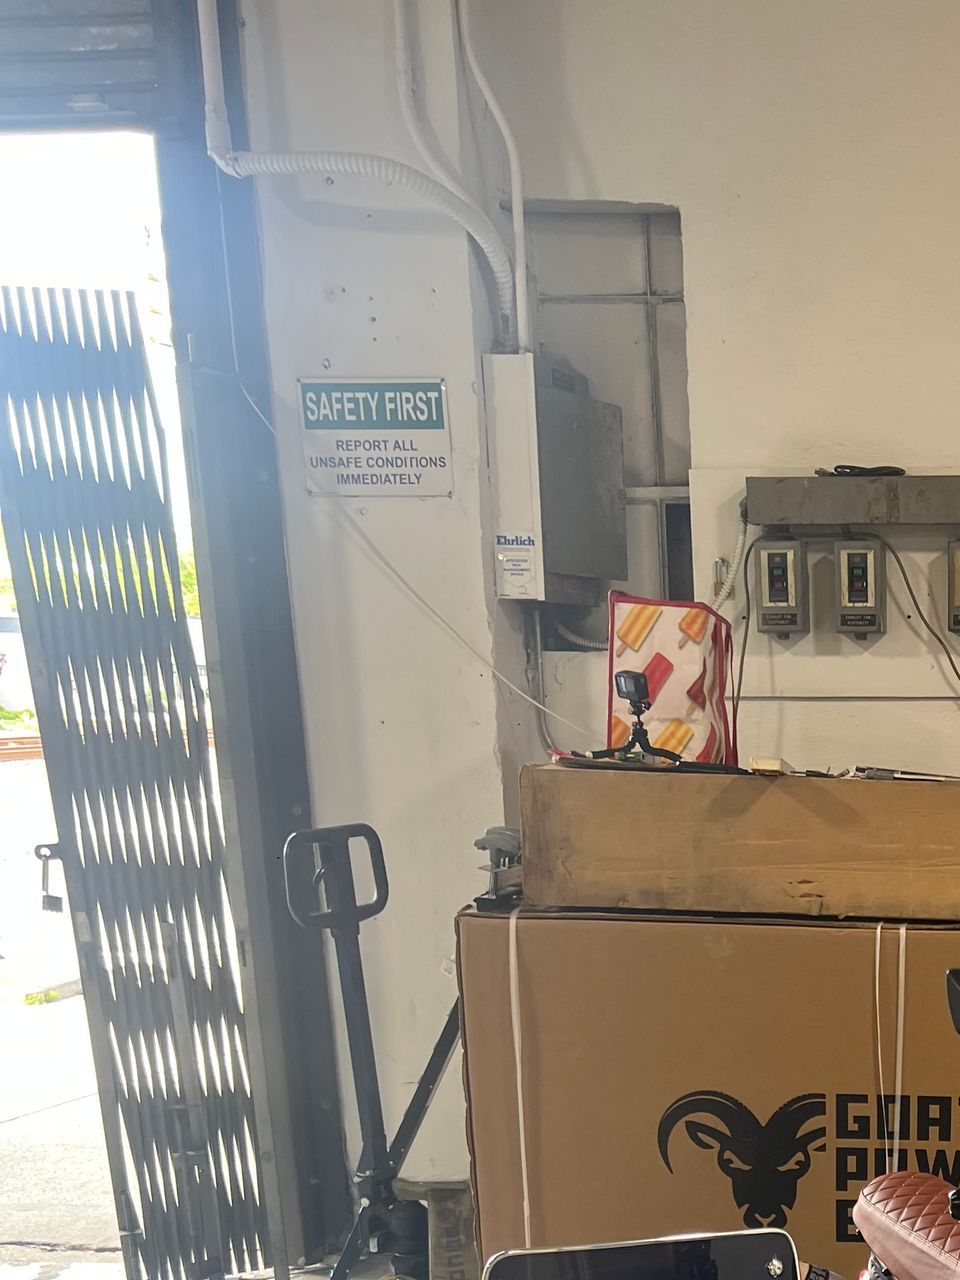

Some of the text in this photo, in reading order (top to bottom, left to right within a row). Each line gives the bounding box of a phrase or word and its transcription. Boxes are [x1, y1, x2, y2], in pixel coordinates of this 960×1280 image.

[306, 391, 439, 421] SAFETY FIRST
[336, 440, 418, 451] REPORT ALL
[310, 457, 447, 469] UNSAFE CONDITIONS
[337, 473, 422, 485] IMMEDIATELY
[496, 535, 535, 546] Ehrlich
